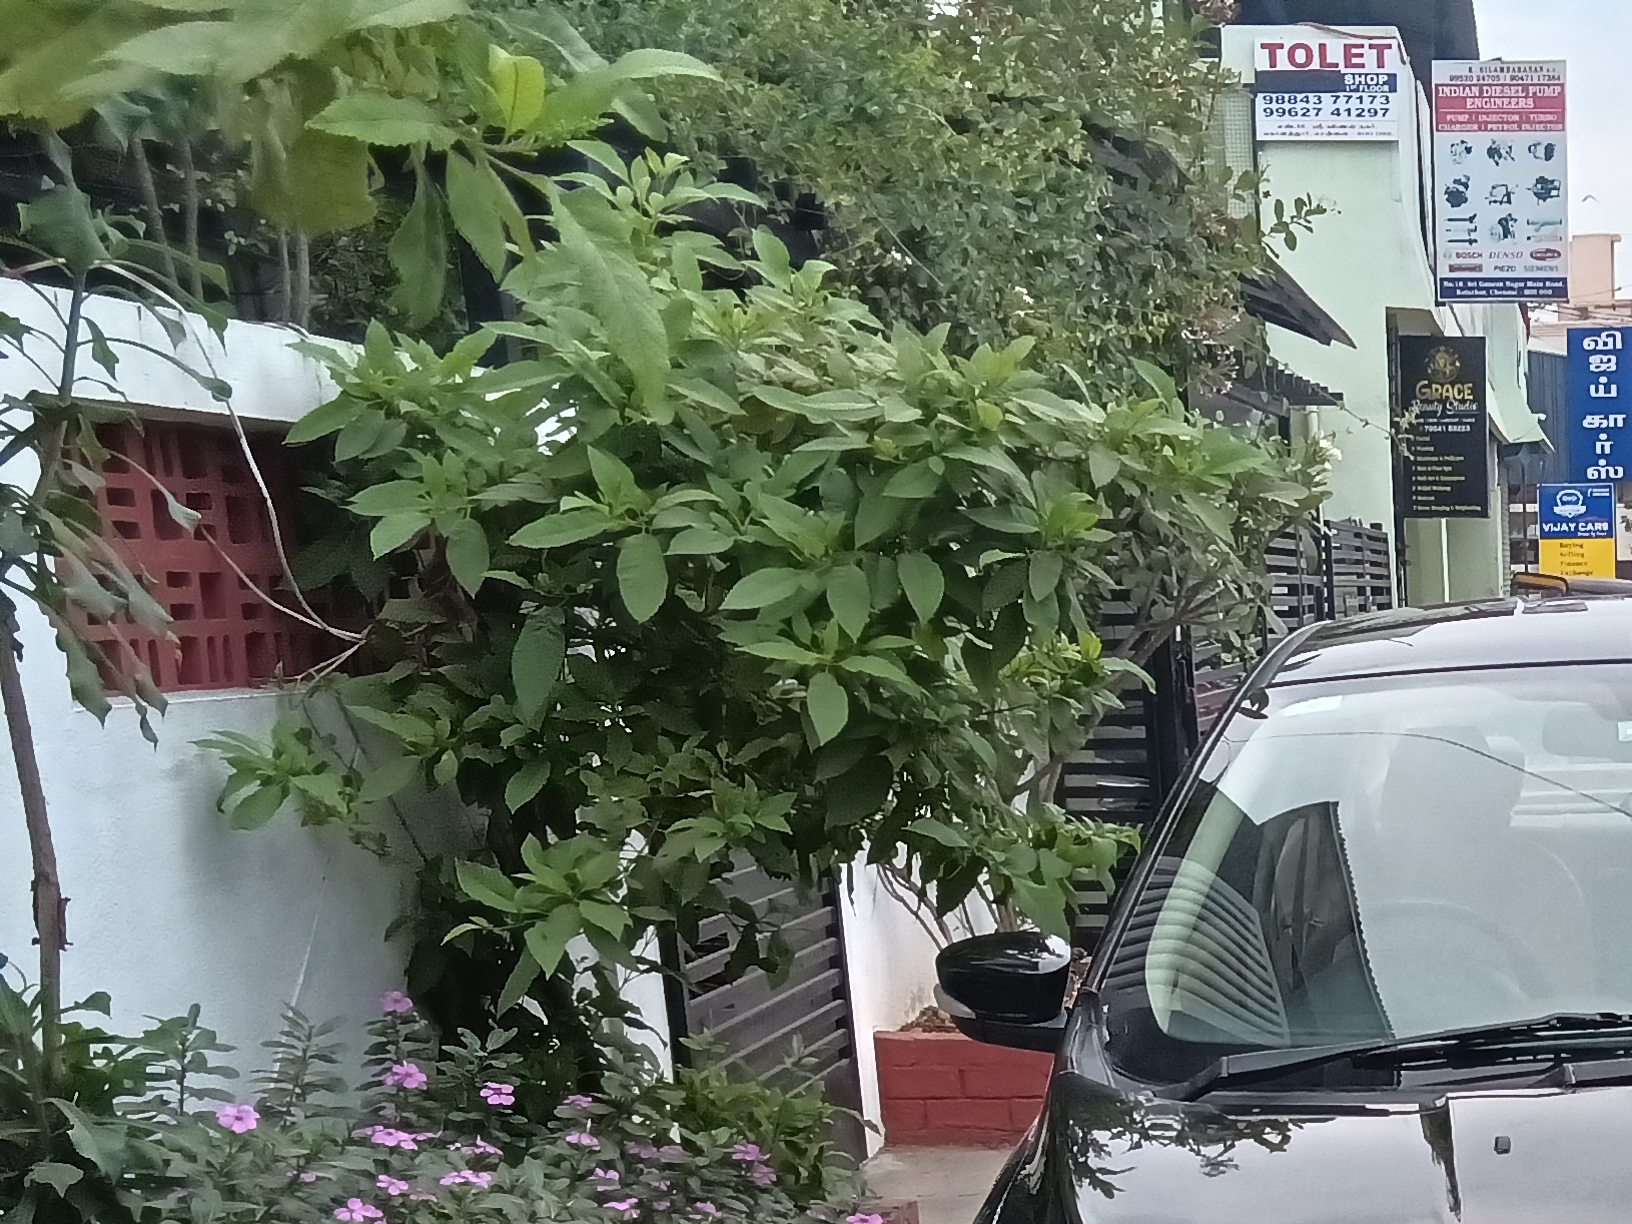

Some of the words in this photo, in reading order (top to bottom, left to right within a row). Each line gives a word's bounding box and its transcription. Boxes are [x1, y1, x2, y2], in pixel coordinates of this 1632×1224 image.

[1260, 42, 1393, 69] TOLET
[1344, 74, 1389, 85] SHOP
[1438, 85, 1480, 97] INDIAN
[1483, 85, 1526, 97] DIESEL
[1528, 85, 1562, 96] PUMP
[1262, 94, 1323, 105] 98843
[1330, 94, 1391, 105] 77173
[1466, 97, 1535, 108] ENGINEERS
[1263, 107, 1323, 117] 99627
[1330, 107, 1390, 117] 41297
[1455, 251, 1483, 259] BOSCH
[1488, 251, 1524, 259] DENSO
[1583, 330, 1623, 398] விஜய்
[1415, 380, 1474, 400] GRACE
[1445, 399, 1479, 415] Studio
[1582, 414, 1627, 480] கார்ஸ்
[1542, 522, 1577, 533] VIJAY
[1578, 522, 1609, 532] CARS
